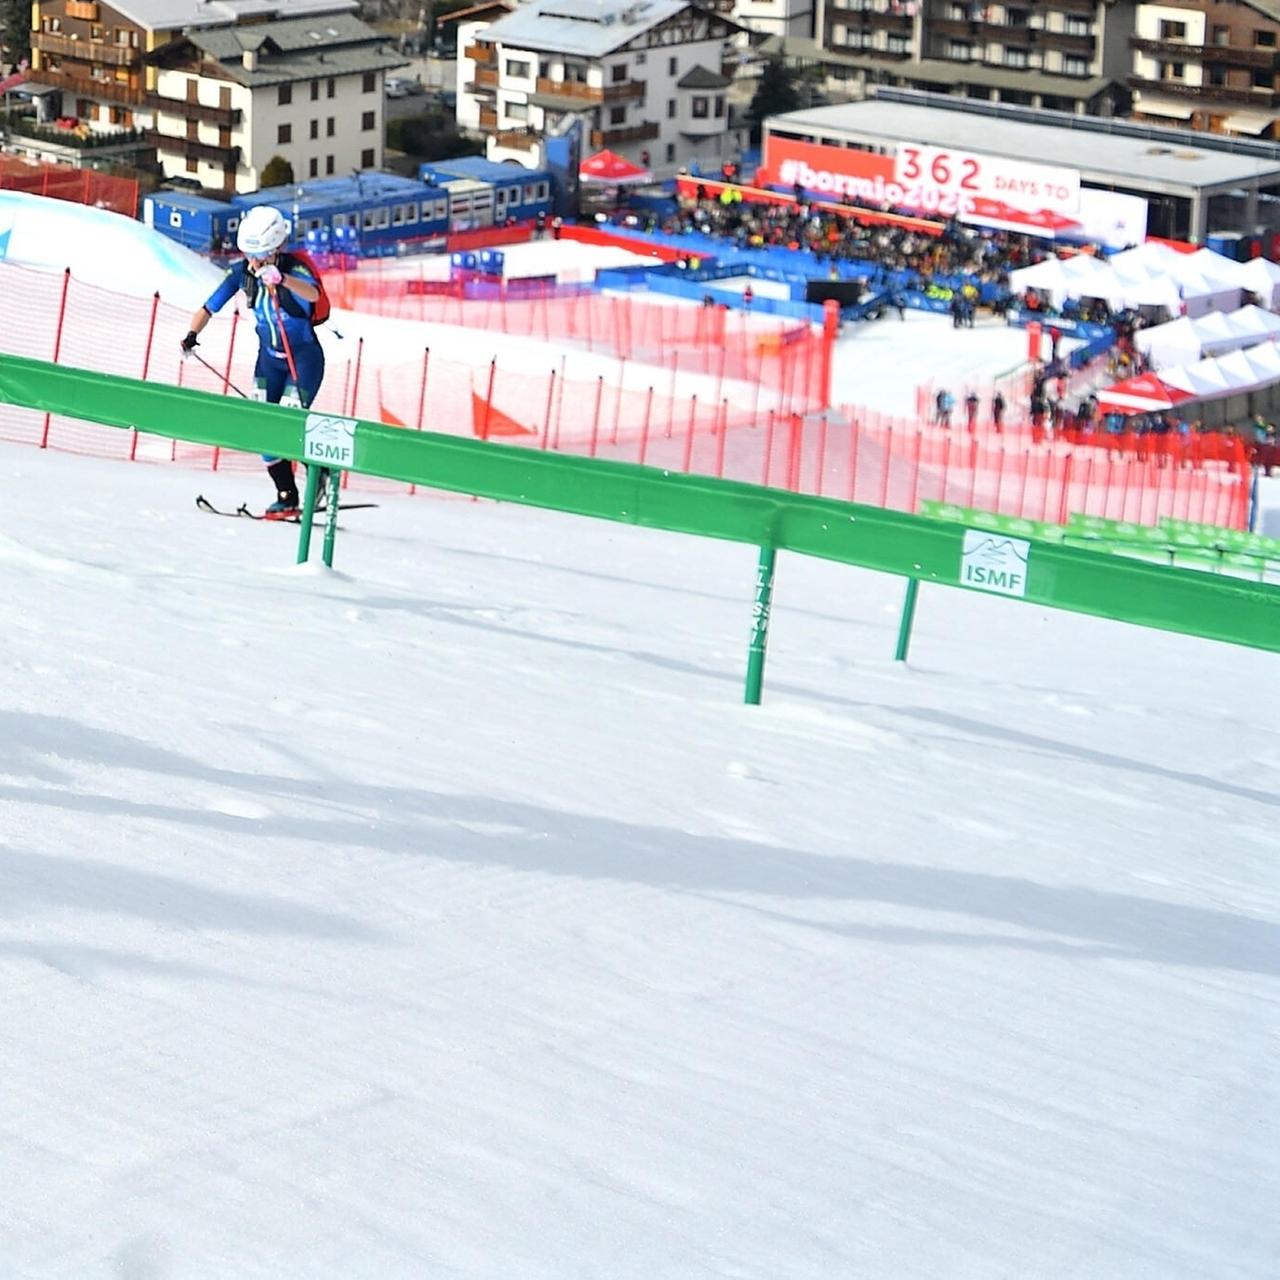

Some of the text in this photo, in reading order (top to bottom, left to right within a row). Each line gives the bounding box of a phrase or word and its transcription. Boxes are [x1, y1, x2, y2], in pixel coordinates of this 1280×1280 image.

[994, 175, 1038, 195] DAYS
[1045, 183, 1070, 201] TO
[309, 441, 351, 462] ISMF
[966, 565, 1023, 590] ISMF
